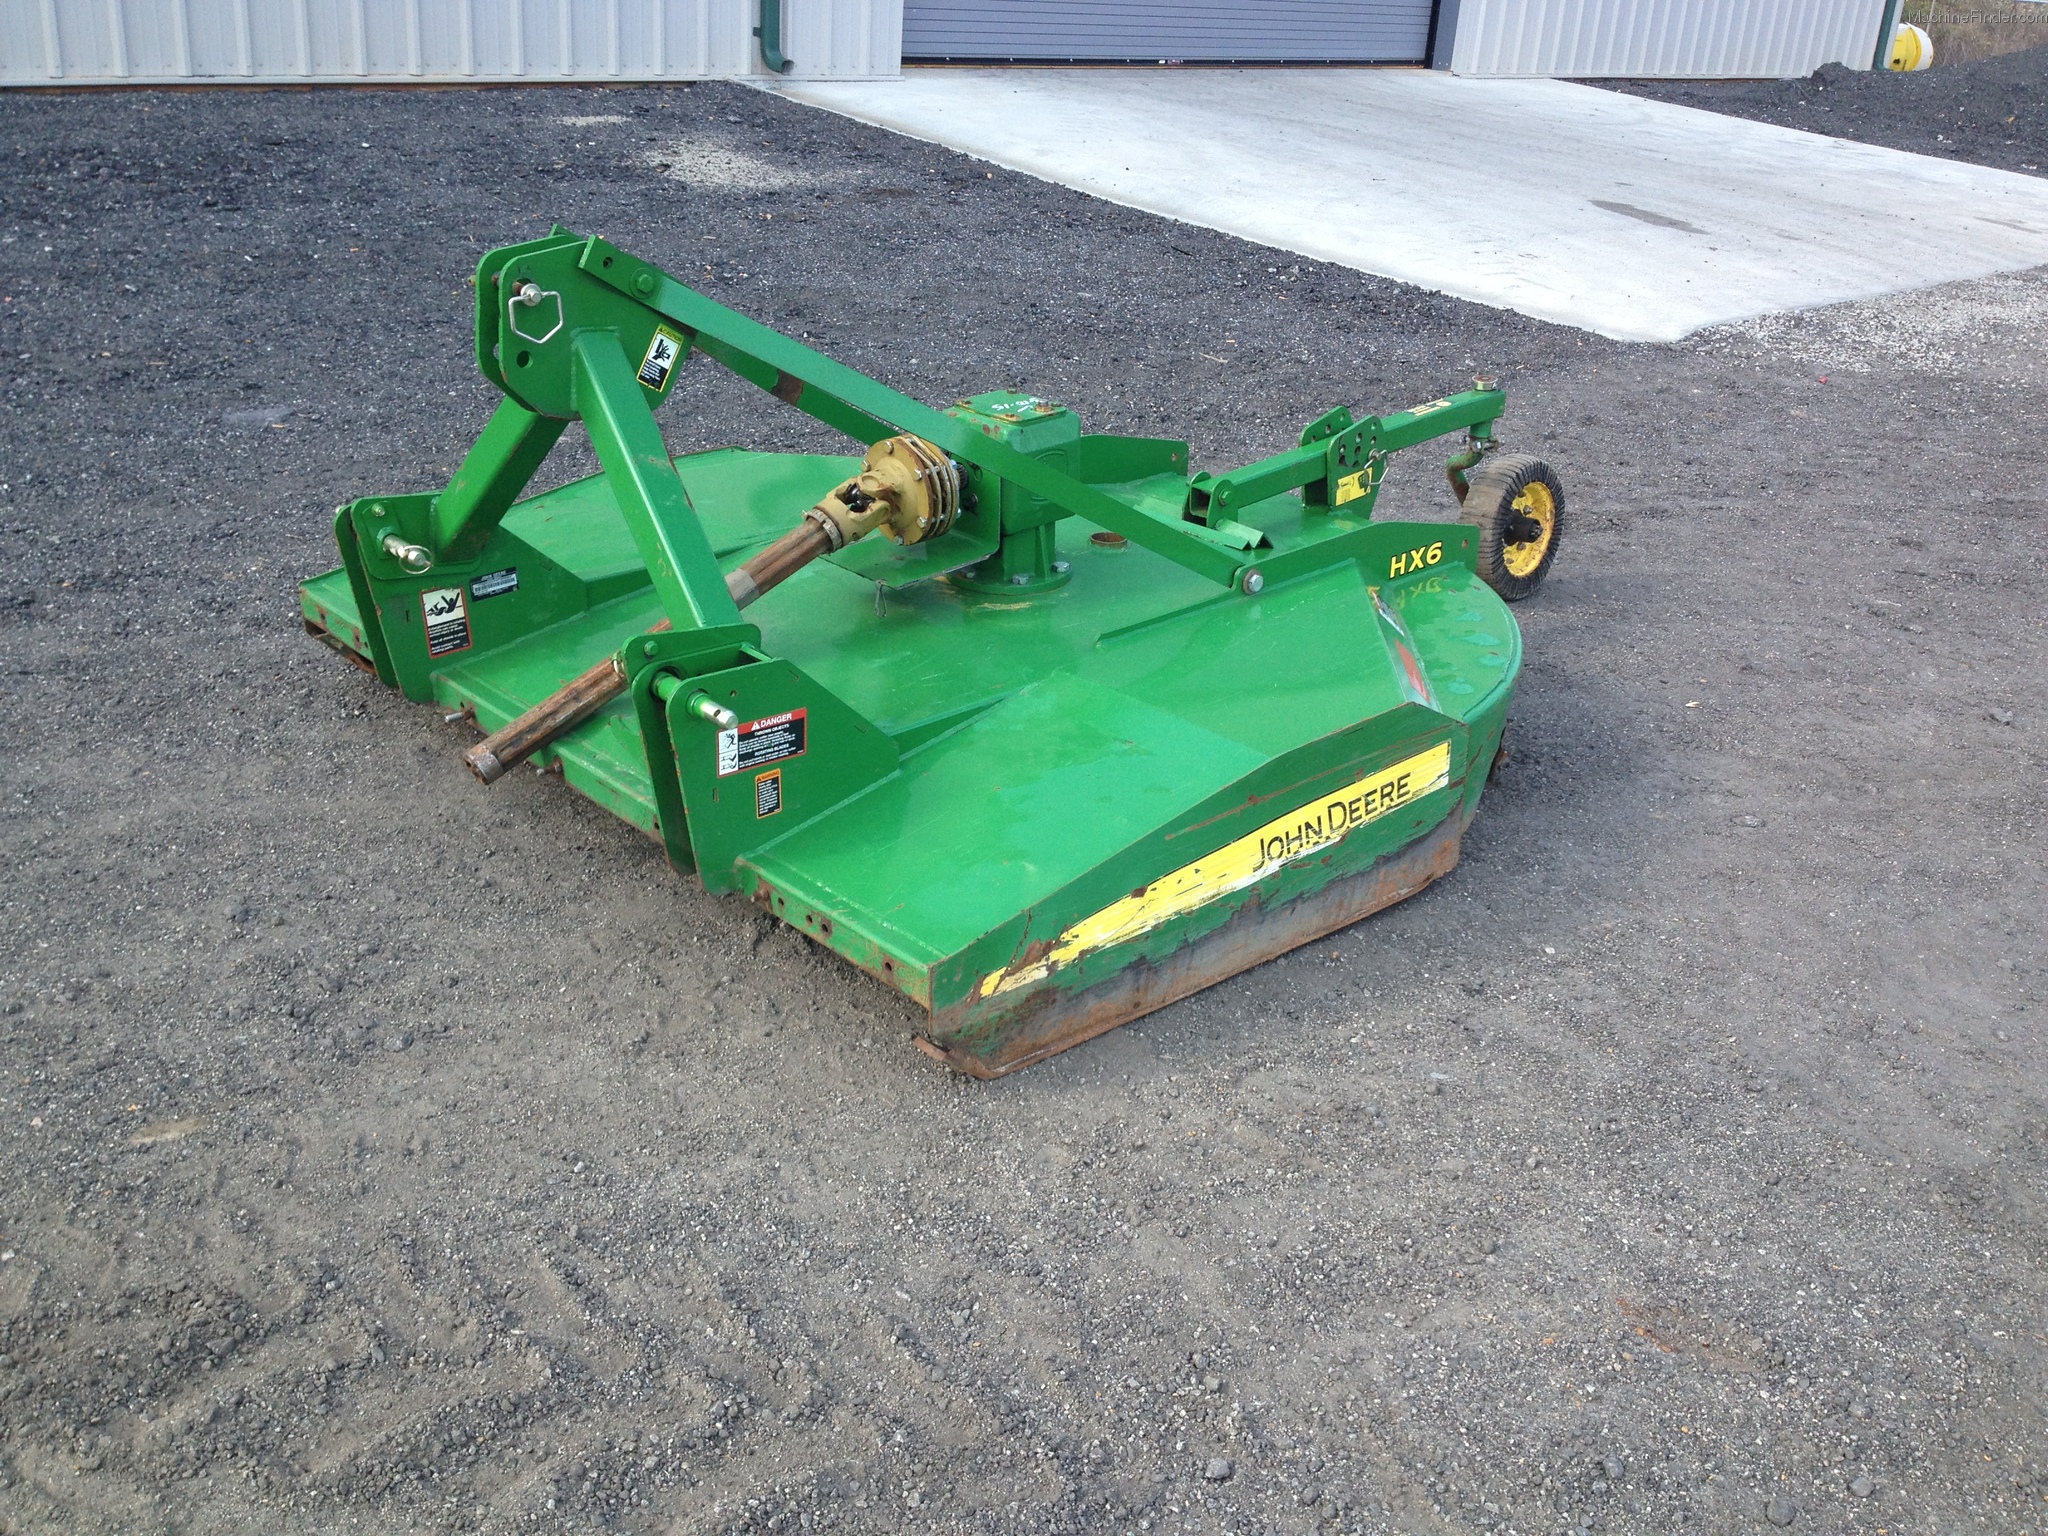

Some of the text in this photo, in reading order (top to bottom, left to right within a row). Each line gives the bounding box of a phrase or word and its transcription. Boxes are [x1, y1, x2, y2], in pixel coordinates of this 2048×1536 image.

[1389, 540, 1443, 580] HX6
[760, 713, 792, 728] DANGER
[1252, 772, 1412, 872] JOHN DEERE
